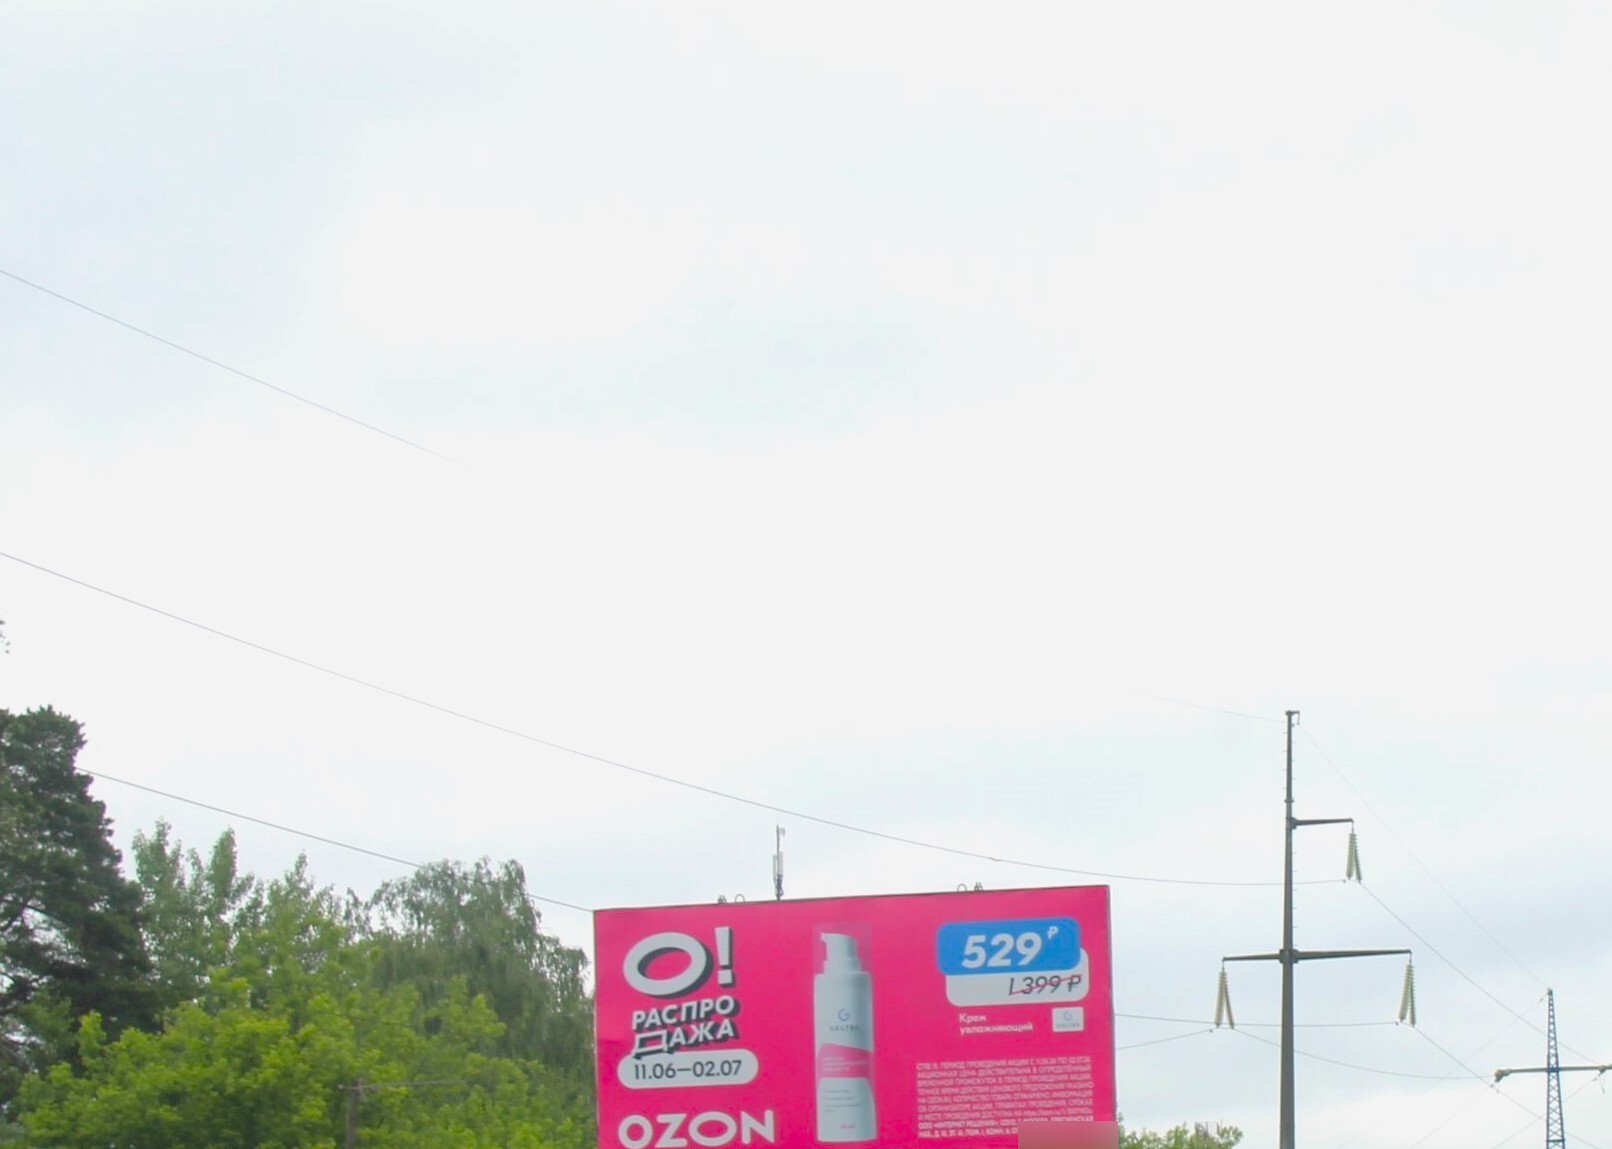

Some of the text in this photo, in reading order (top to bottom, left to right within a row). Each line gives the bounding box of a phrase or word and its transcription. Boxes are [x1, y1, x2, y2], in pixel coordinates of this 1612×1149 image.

[961, 932, 1042, 969] 529
[632, 994, 735, 1031] РАСПРО
[959, 1013, 987, 1024] Крем
[959, 1022, 1034, 1036] увлажняющий
[632, 1018, 735, 1056] ДАЖА
[618, 1109, 775, 1149] OZON
